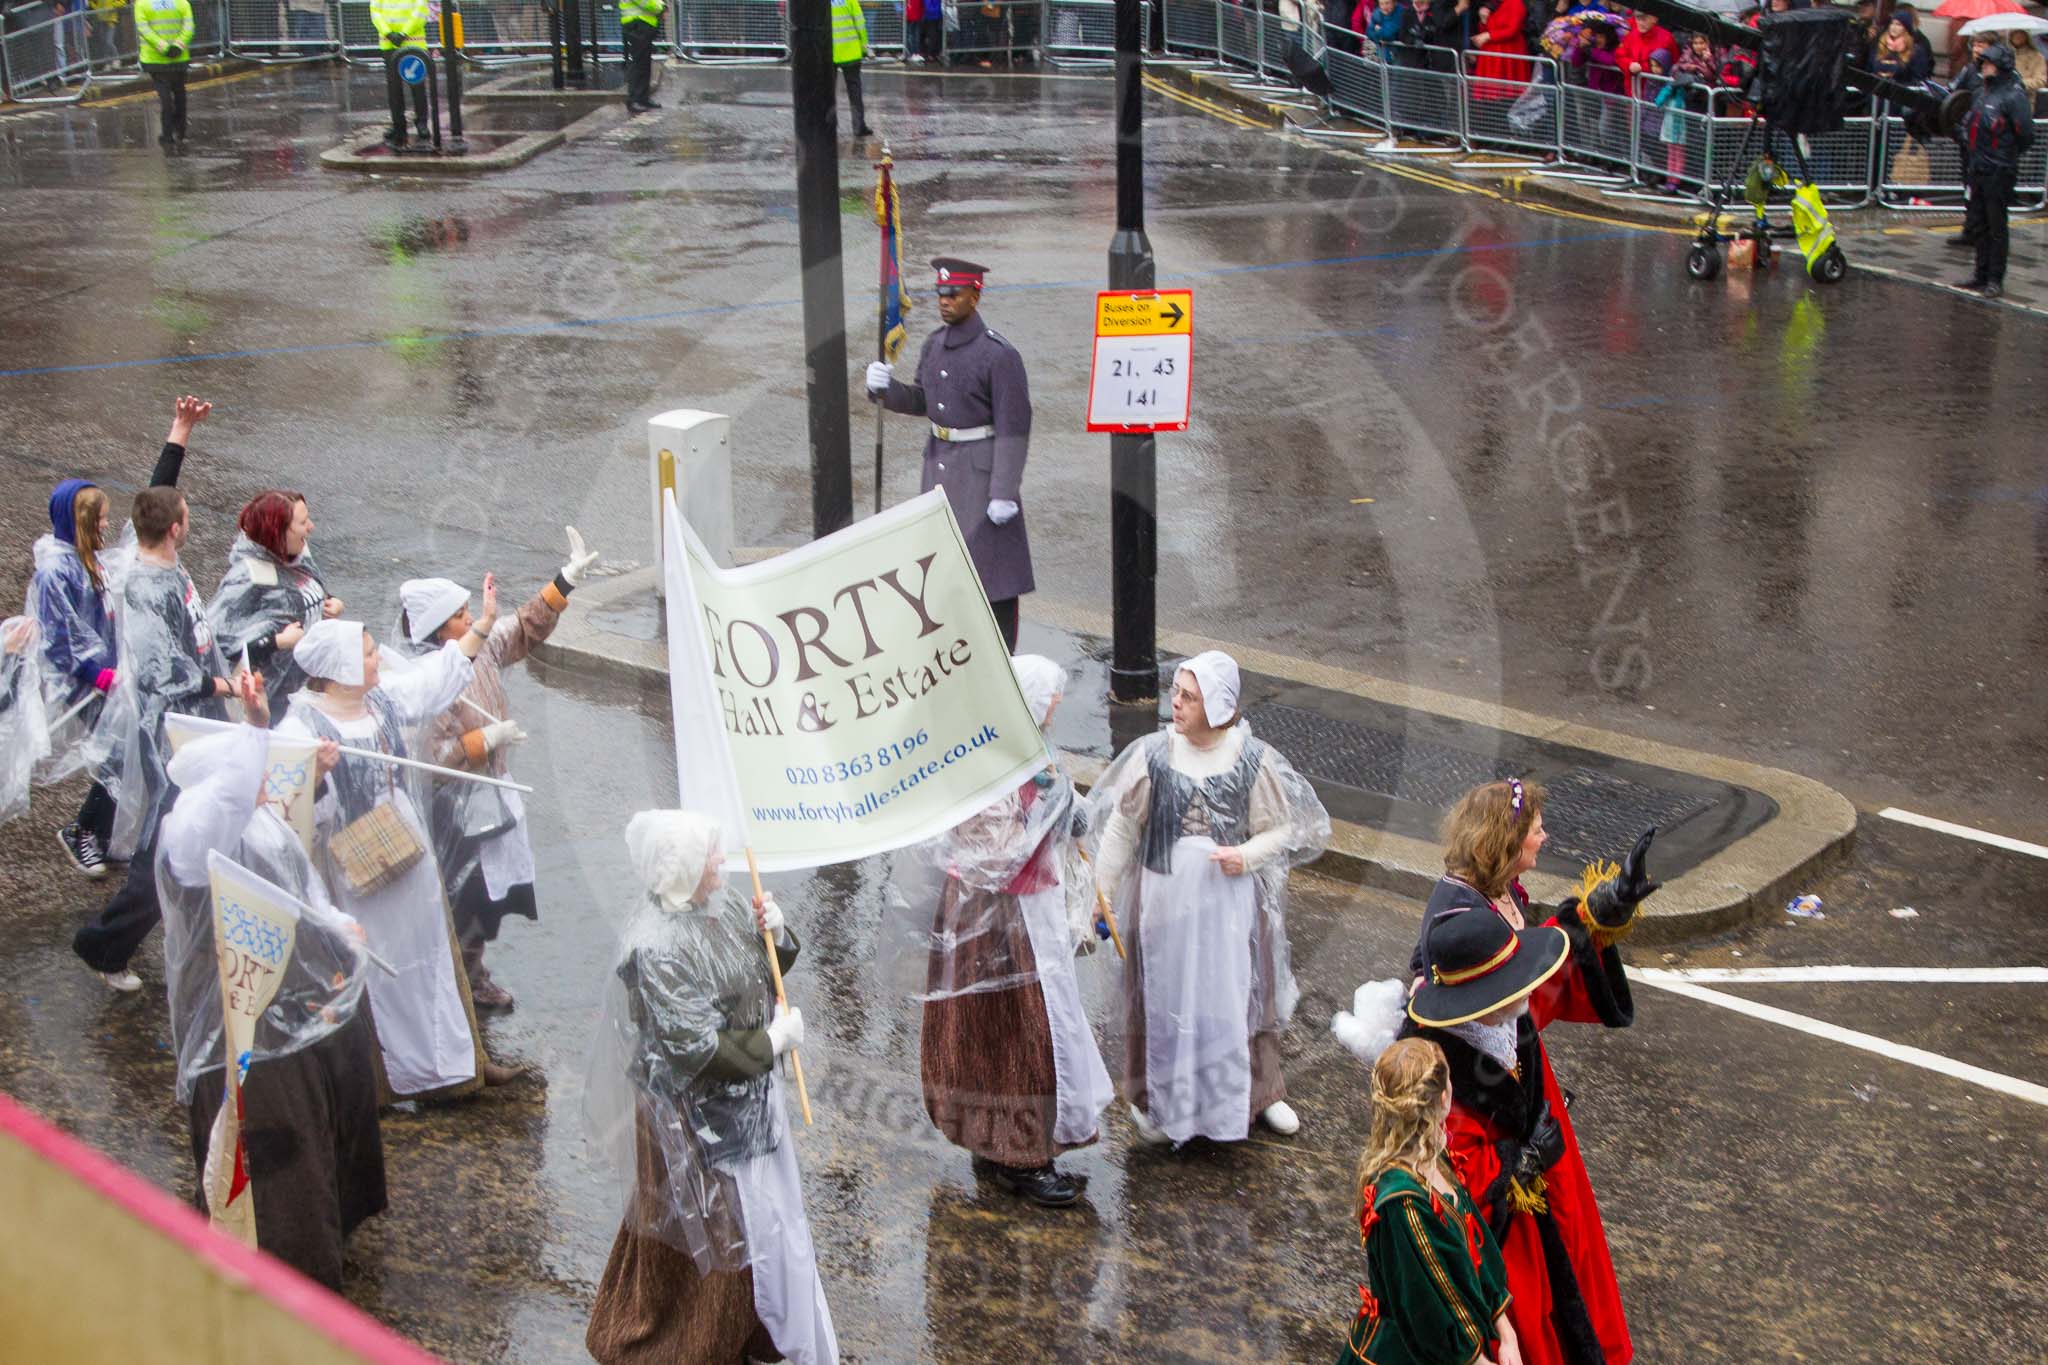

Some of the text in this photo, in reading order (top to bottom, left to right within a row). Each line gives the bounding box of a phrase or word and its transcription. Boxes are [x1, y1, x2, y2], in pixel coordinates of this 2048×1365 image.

[1104, 303, 1150, 312] Buses on
[1104, 317, 1152, 326] Diversion
[1153, 358, 1175, 375] 43
[1127, 389, 1156, 406] 141
[703, 552, 944, 688] FORTY
[718, 638, 972, 736] Hall & Estate
[751, 725, 1000, 824] www.fortyhallestate.co.uk
[786, 728, 928, 785] 020 8363 8196
